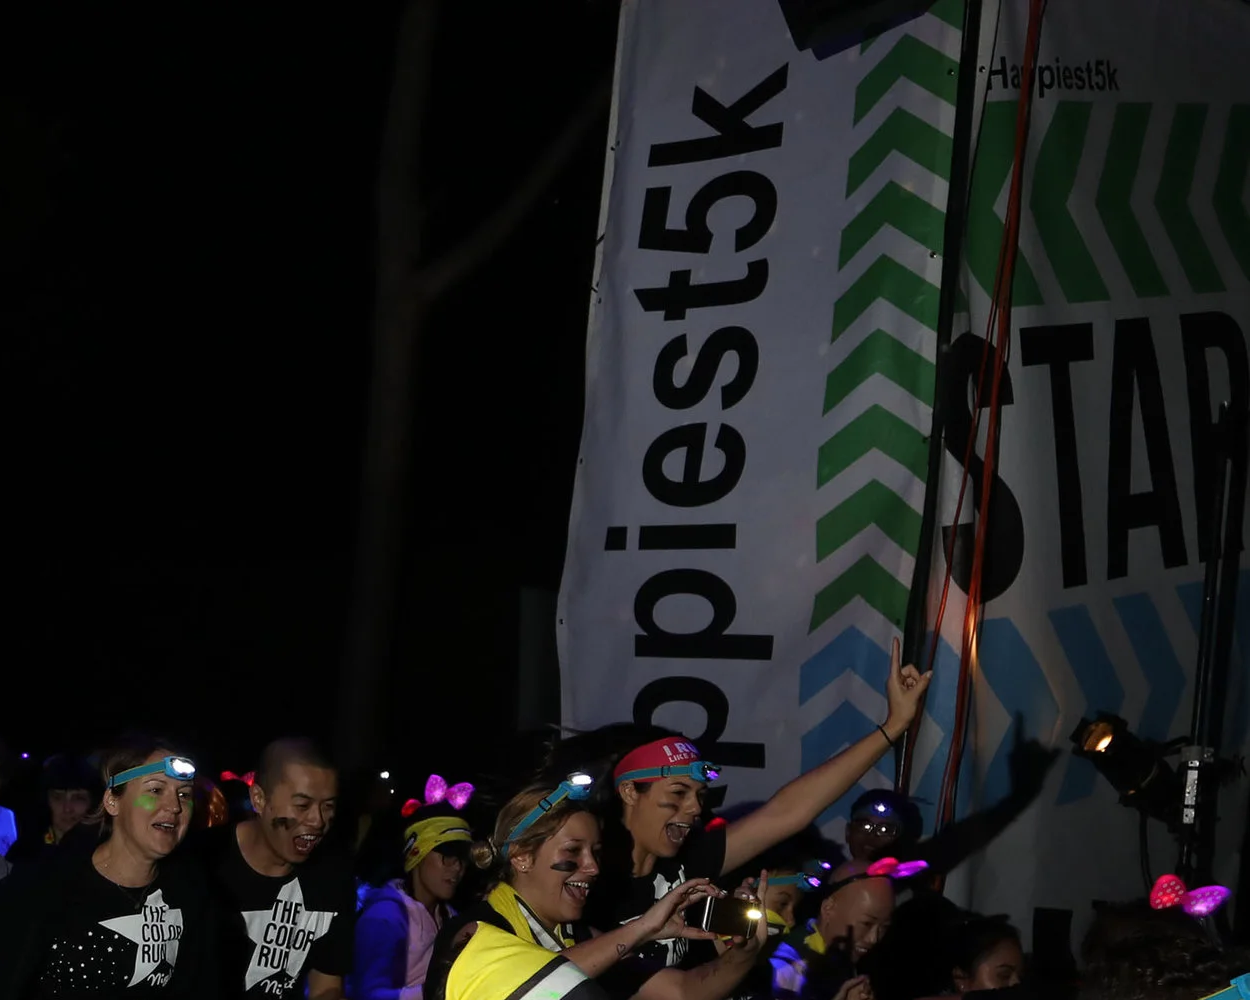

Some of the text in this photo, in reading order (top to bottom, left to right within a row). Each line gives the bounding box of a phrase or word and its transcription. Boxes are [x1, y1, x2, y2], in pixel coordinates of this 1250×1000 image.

[605, 62, 788, 815] ppiest5k
[143, 905, 168, 922] THE
[272, 900, 302, 925] THE
[142, 924, 183, 943] COLOR
[264, 923, 315, 951] COLOR
[142, 944, 168, 963] RUN
